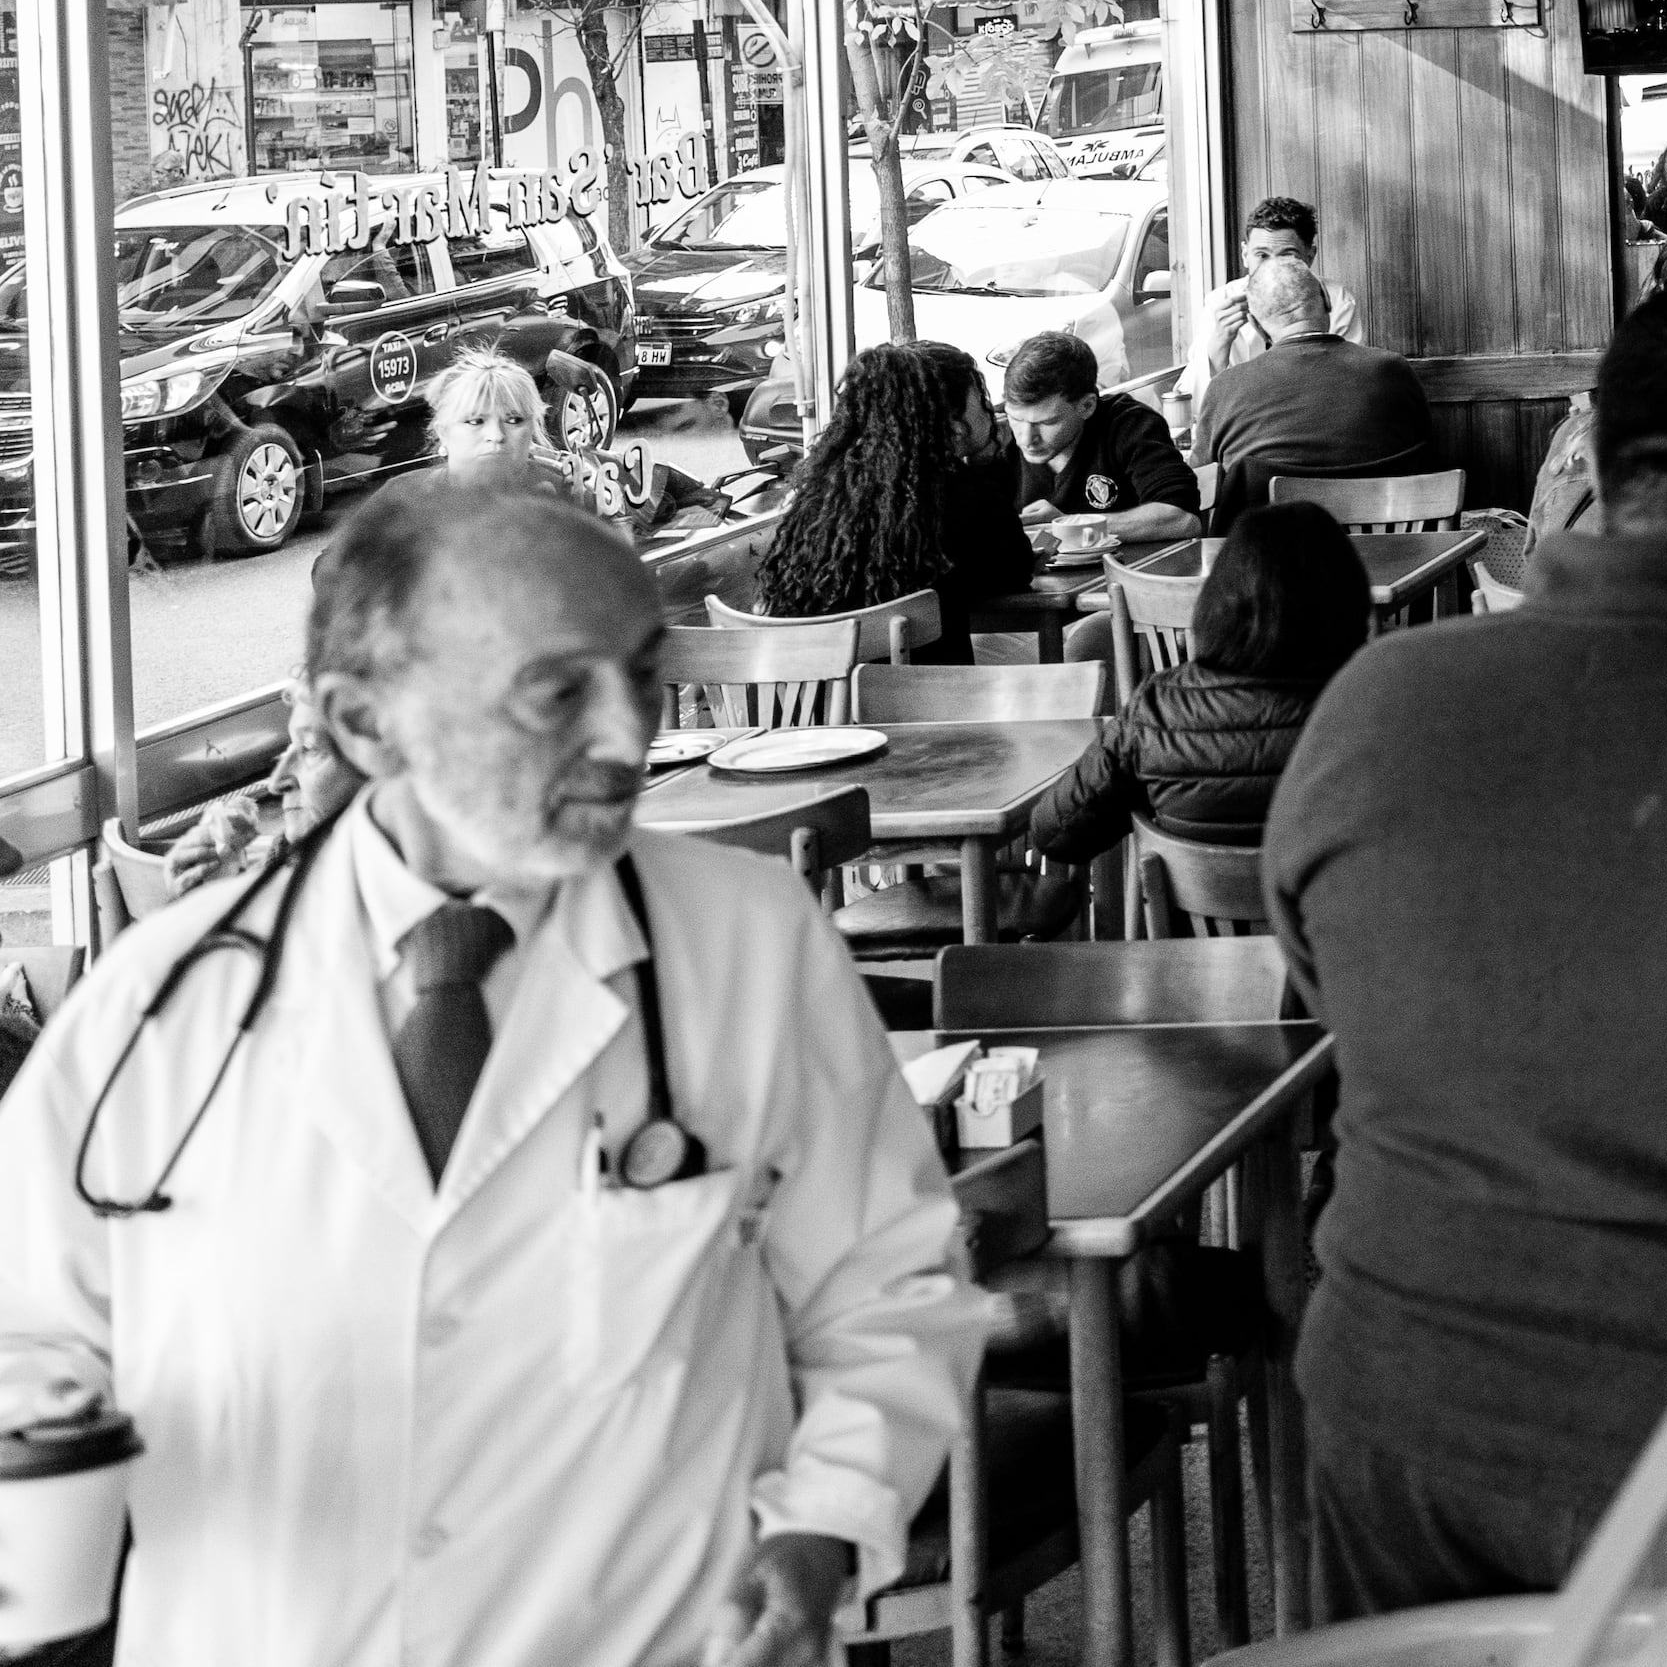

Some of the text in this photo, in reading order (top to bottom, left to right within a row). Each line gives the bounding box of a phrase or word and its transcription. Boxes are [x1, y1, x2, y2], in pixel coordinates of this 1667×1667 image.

[381, 340, 401, 353] TAXI
[651, 350, 667, 364] HW
[377, 355, 410, 379] 15973
